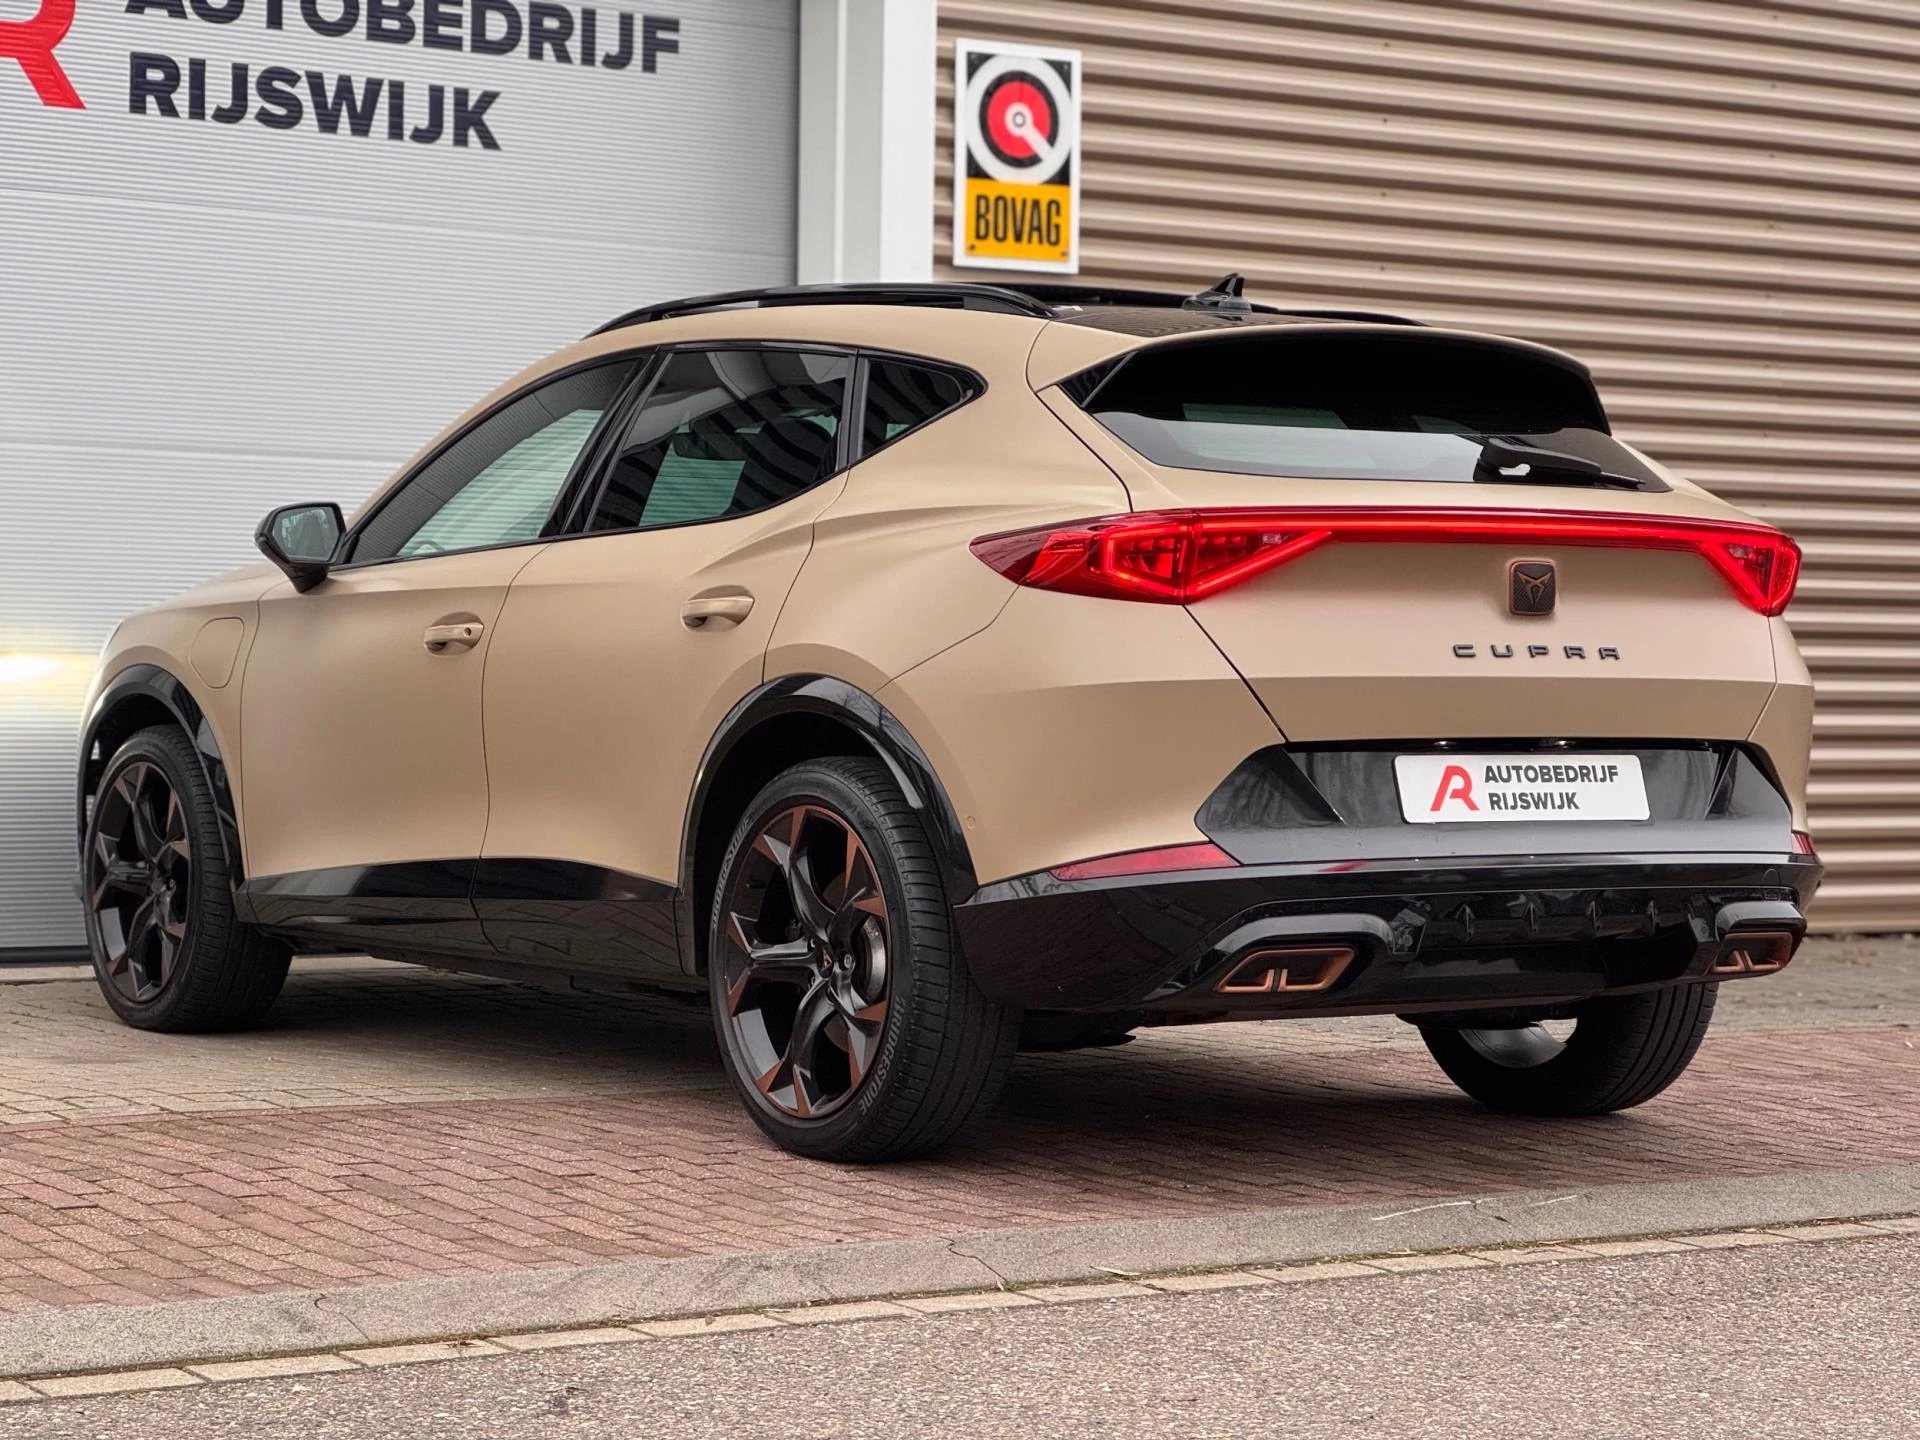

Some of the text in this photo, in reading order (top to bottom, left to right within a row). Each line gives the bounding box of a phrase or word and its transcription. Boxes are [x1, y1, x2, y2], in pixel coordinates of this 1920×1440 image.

[125, 0, 680, 74] OBEDRIJF
[129, 51, 502, 151] RIJSWIJK
[975, 195, 1060, 247] BOVAG
[1453, 644, 1620, 660] CUPRA
[1484, 765, 1619, 783] AUTOBEDRIJF
[1488, 792, 1580, 811] RIJSWIJK
